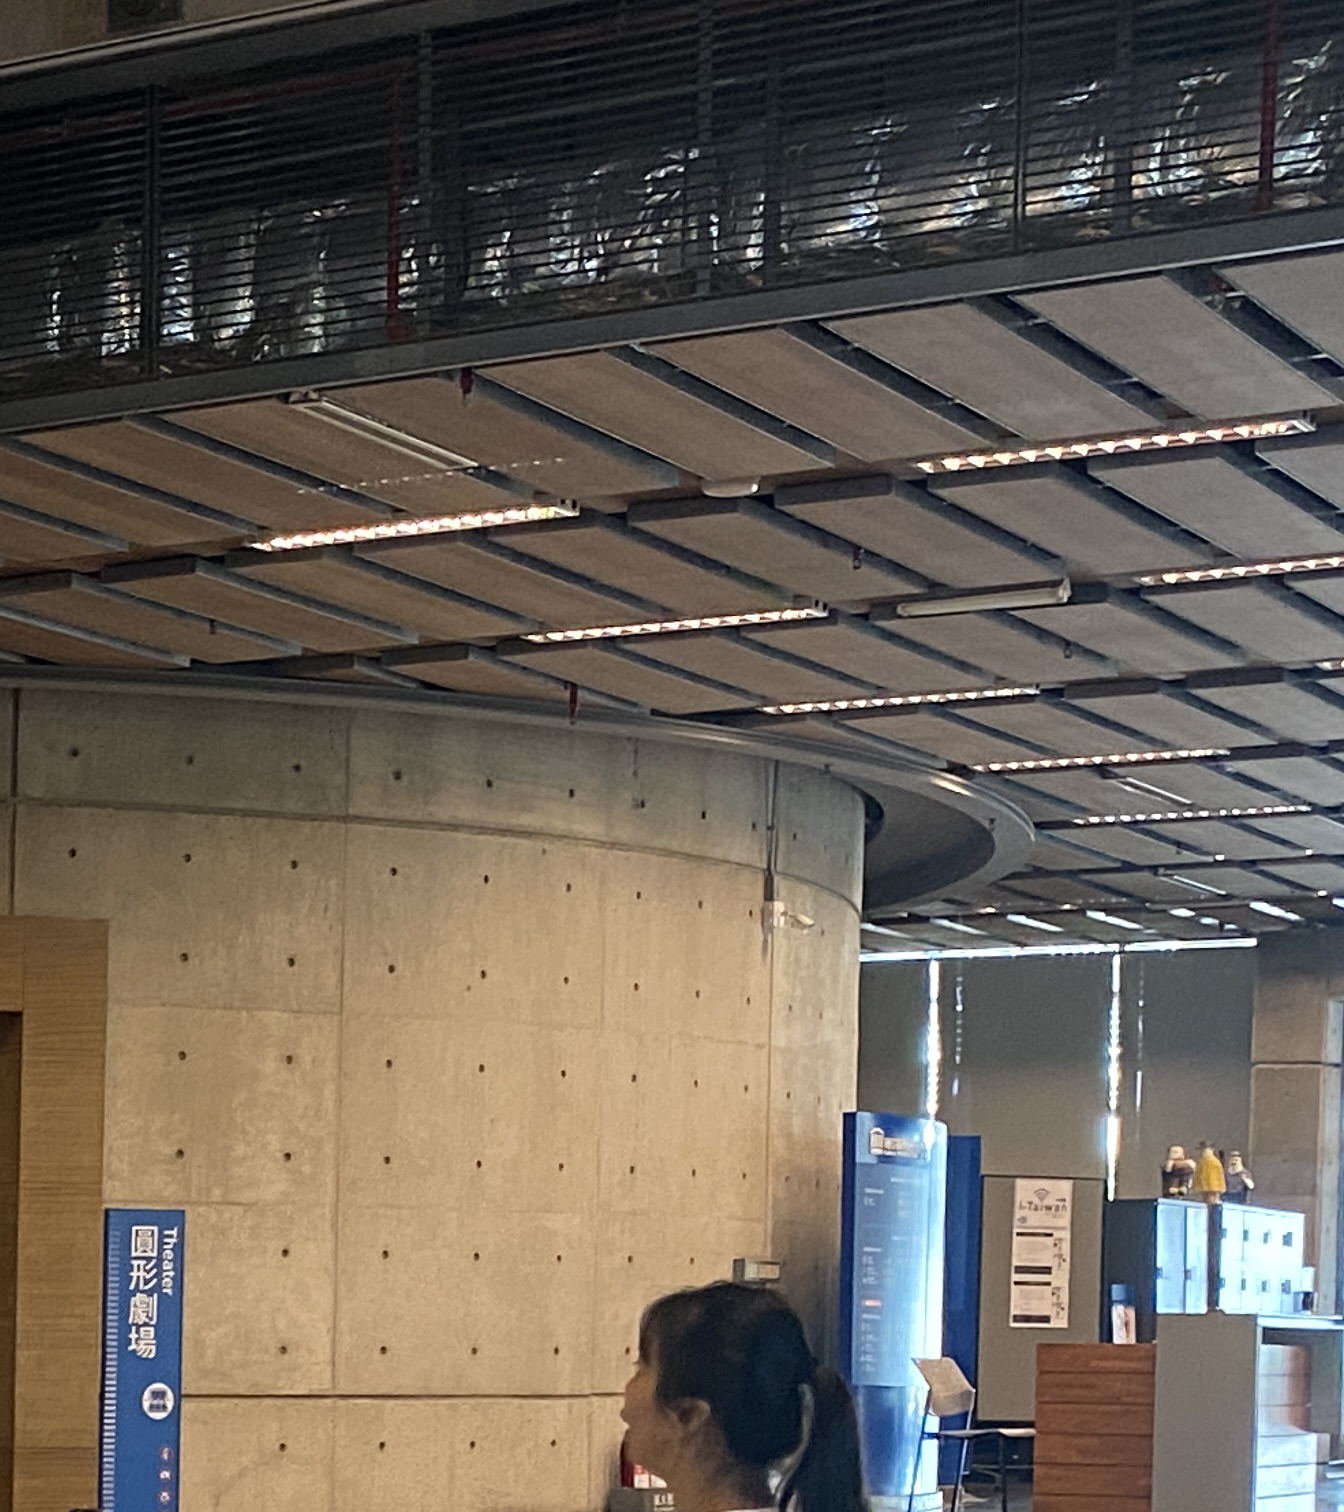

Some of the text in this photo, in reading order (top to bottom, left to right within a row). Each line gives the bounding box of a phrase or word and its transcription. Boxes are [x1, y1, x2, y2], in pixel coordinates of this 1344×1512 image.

[128, 1225, 159, 1359] 圓形劇場
[161, 1226, 178, 1296] Theater
